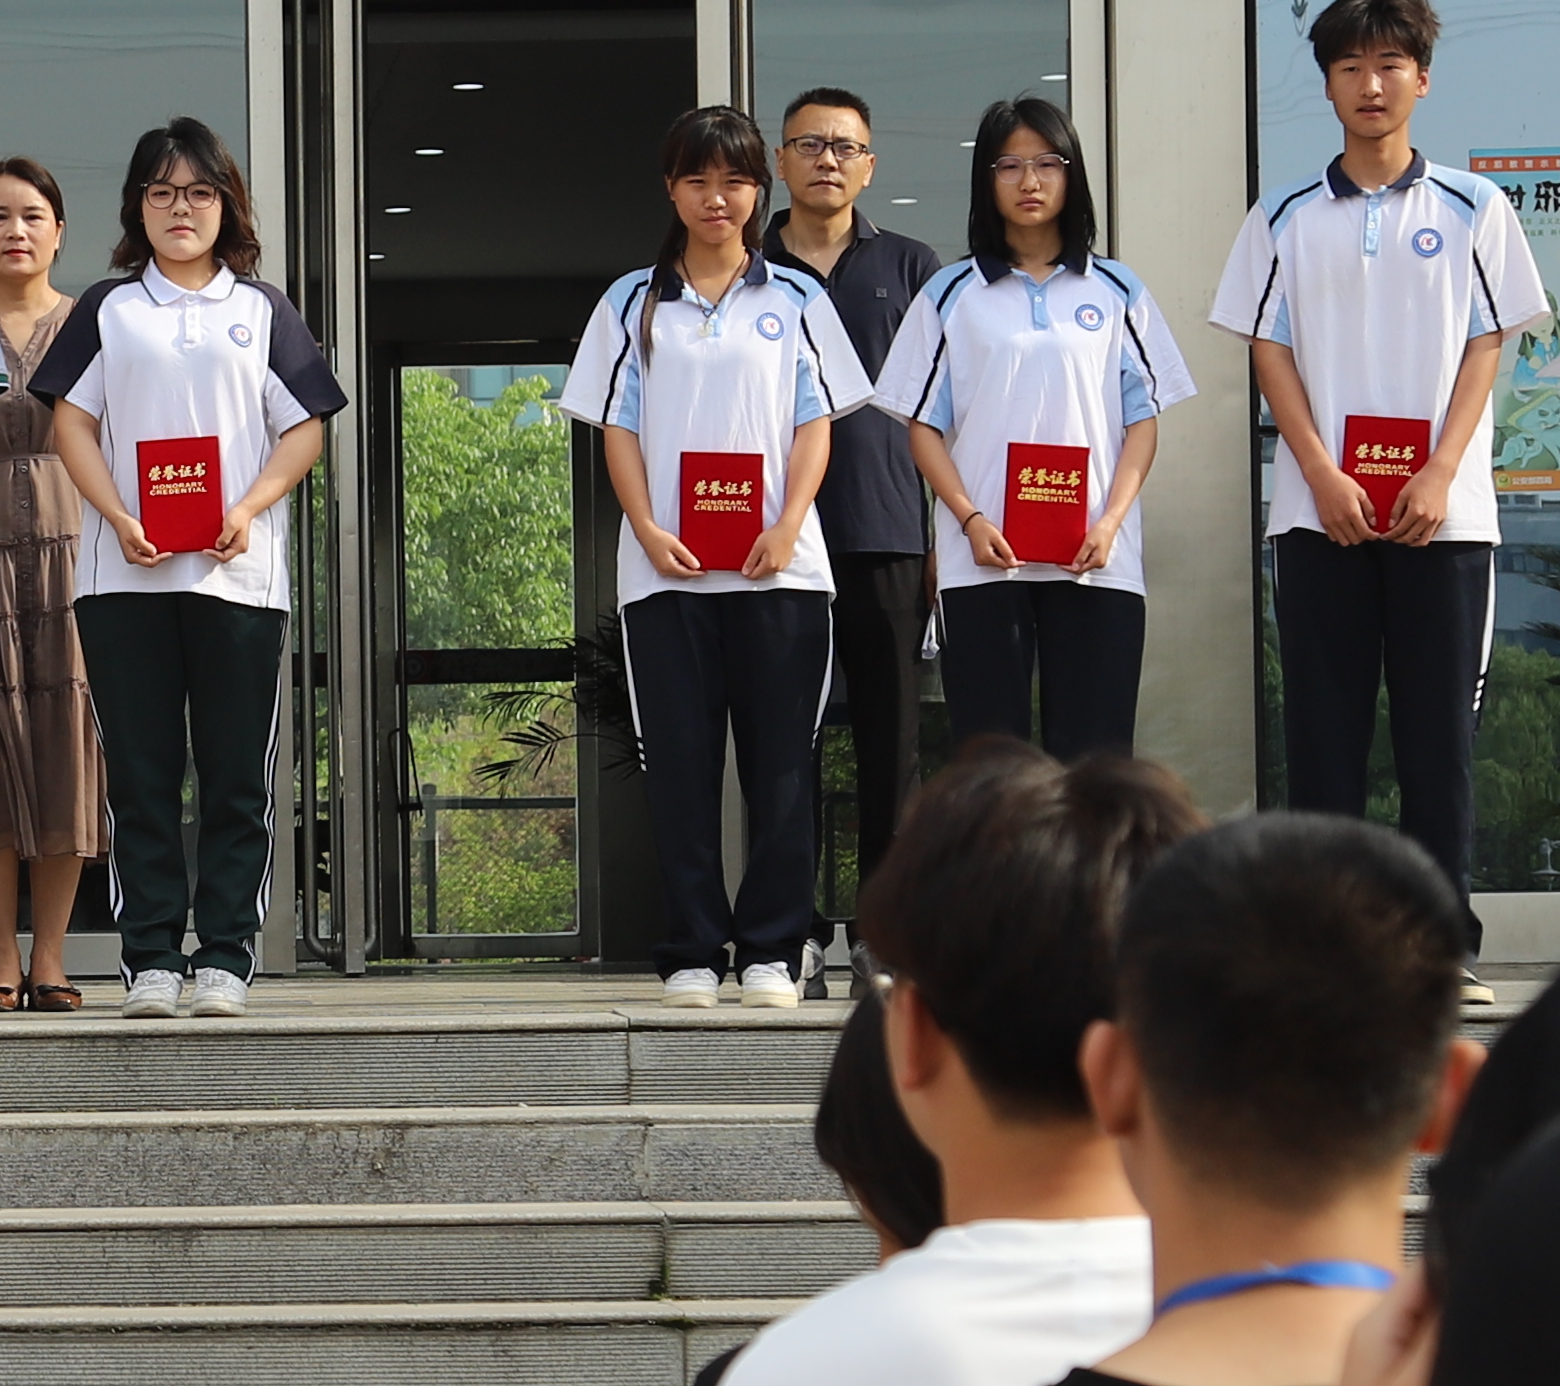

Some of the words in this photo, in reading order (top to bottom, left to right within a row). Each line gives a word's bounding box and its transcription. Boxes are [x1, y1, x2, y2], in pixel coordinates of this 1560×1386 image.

[1354, 441, 1416, 460] 荣誉证书
[148, 461, 207, 482] 荣誉证书
[1354, 466, 1413, 477] CREDENTIAL
[1357, 462, 1411, 471] HONORARY
[1018, 466, 1082, 488] 荣誉证书
[149, 486, 208, 497] CREDENTIAL
[152, 480, 204, 492] HONORARY
[693, 479, 753, 498] 荣誉证书
[1021, 486, 1078, 497] HONORARY
[697, 499, 749, 507] HONORARY
[1017, 493, 1081, 504] CREDENTIAL
[693, 503, 752, 513] CREDENTIAL
